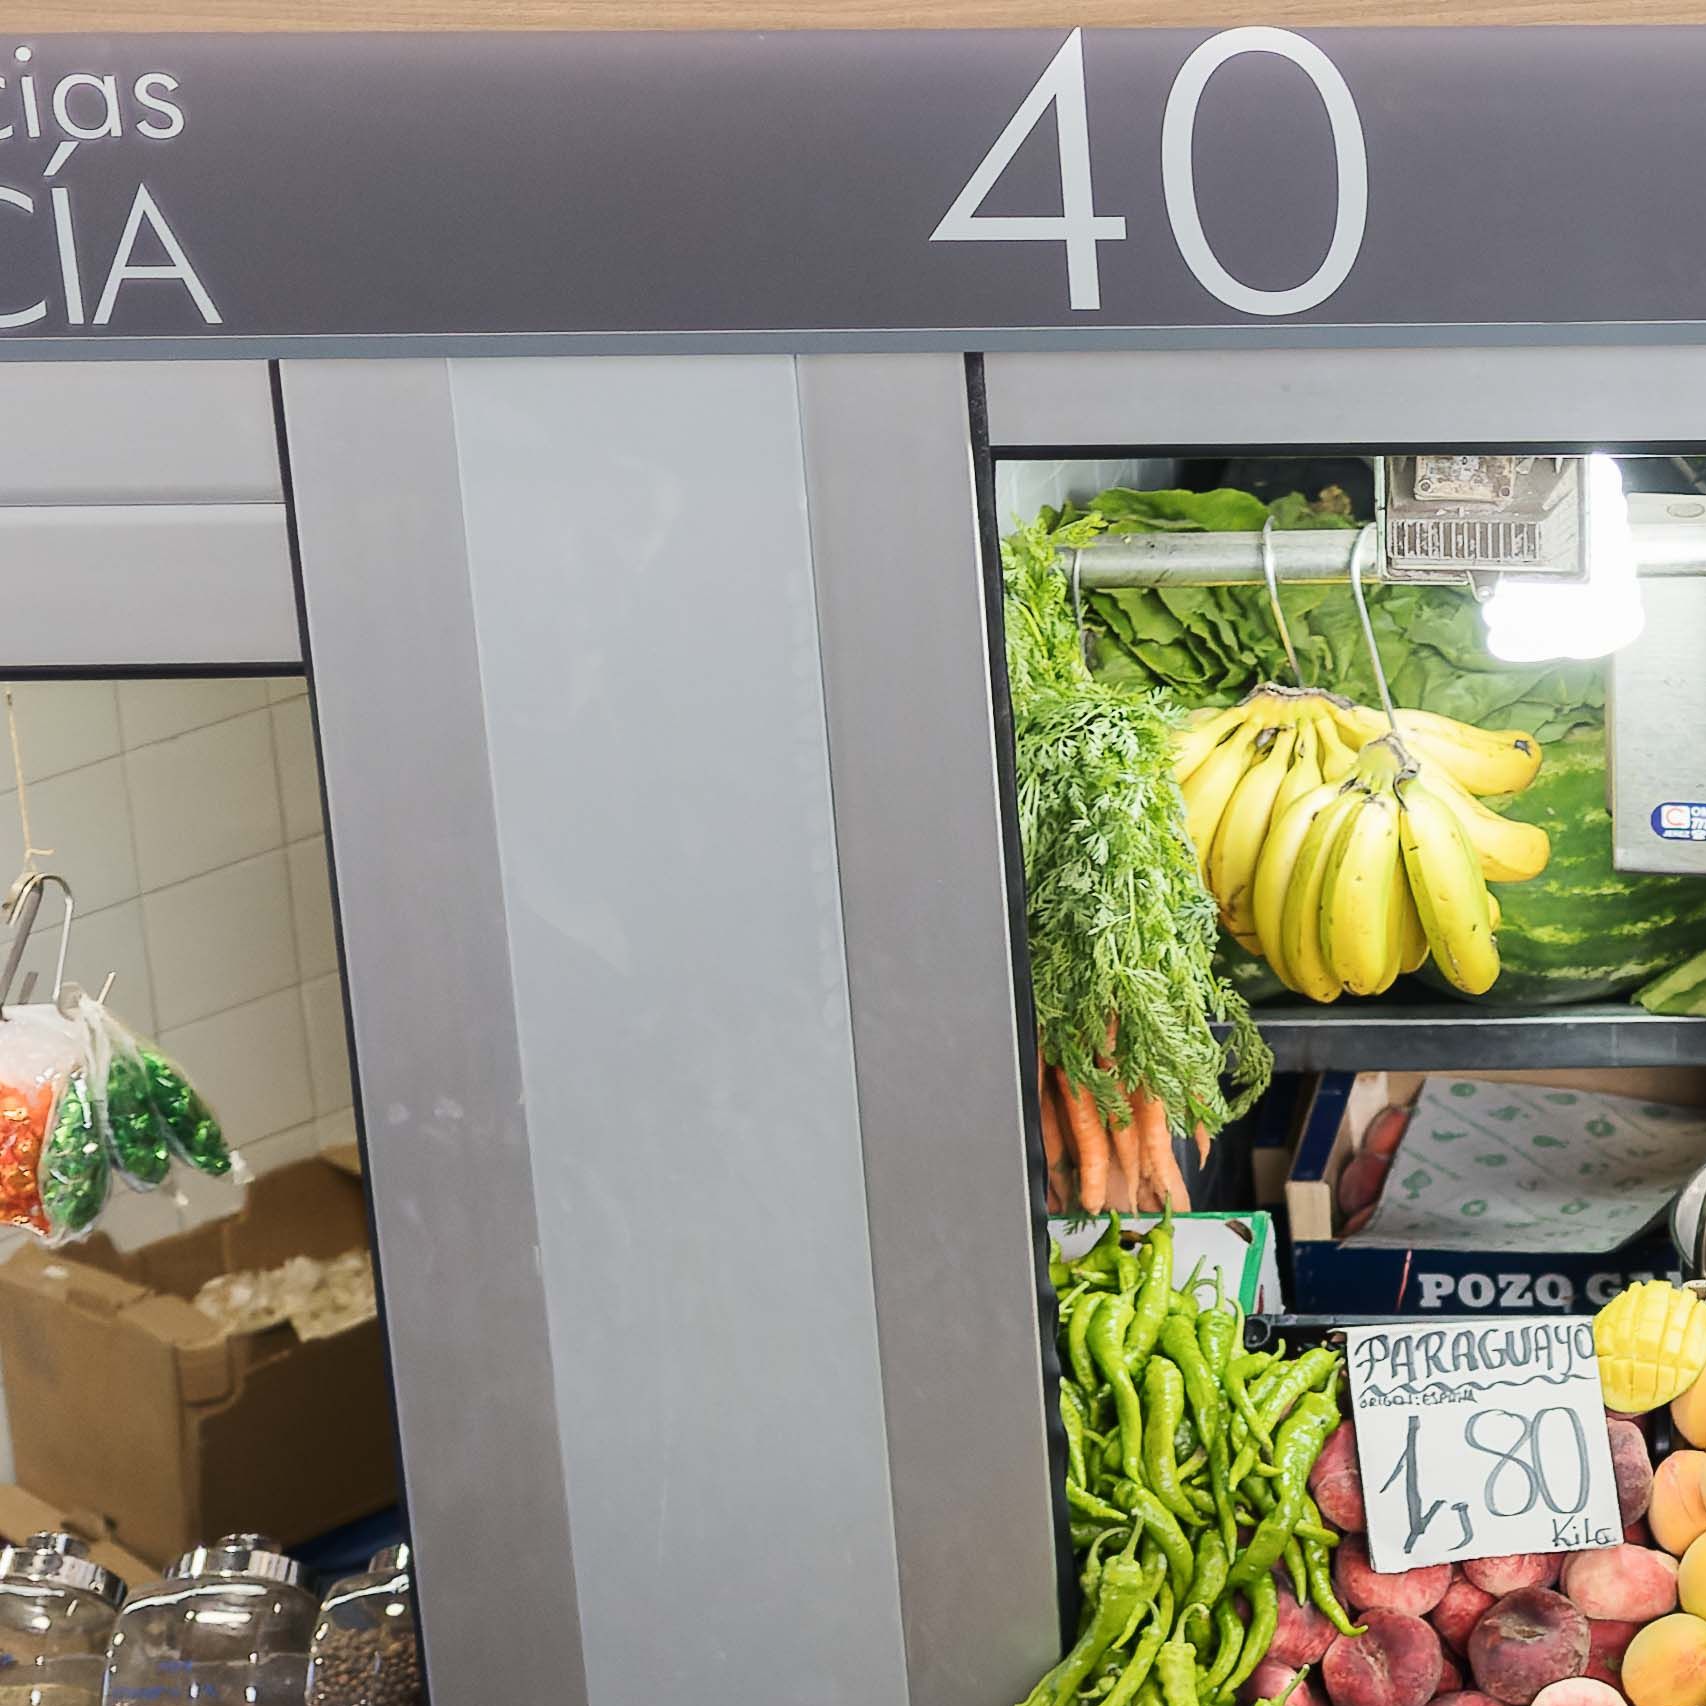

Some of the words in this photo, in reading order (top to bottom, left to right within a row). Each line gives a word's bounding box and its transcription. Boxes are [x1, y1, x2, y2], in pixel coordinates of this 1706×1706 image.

[0, 46, 186, 140] ias
[929, 25, 1369, 316] 40
[1416, 1272, 1573, 1308] POZO
[1379, 1406, 1591, 1554] 1,80
